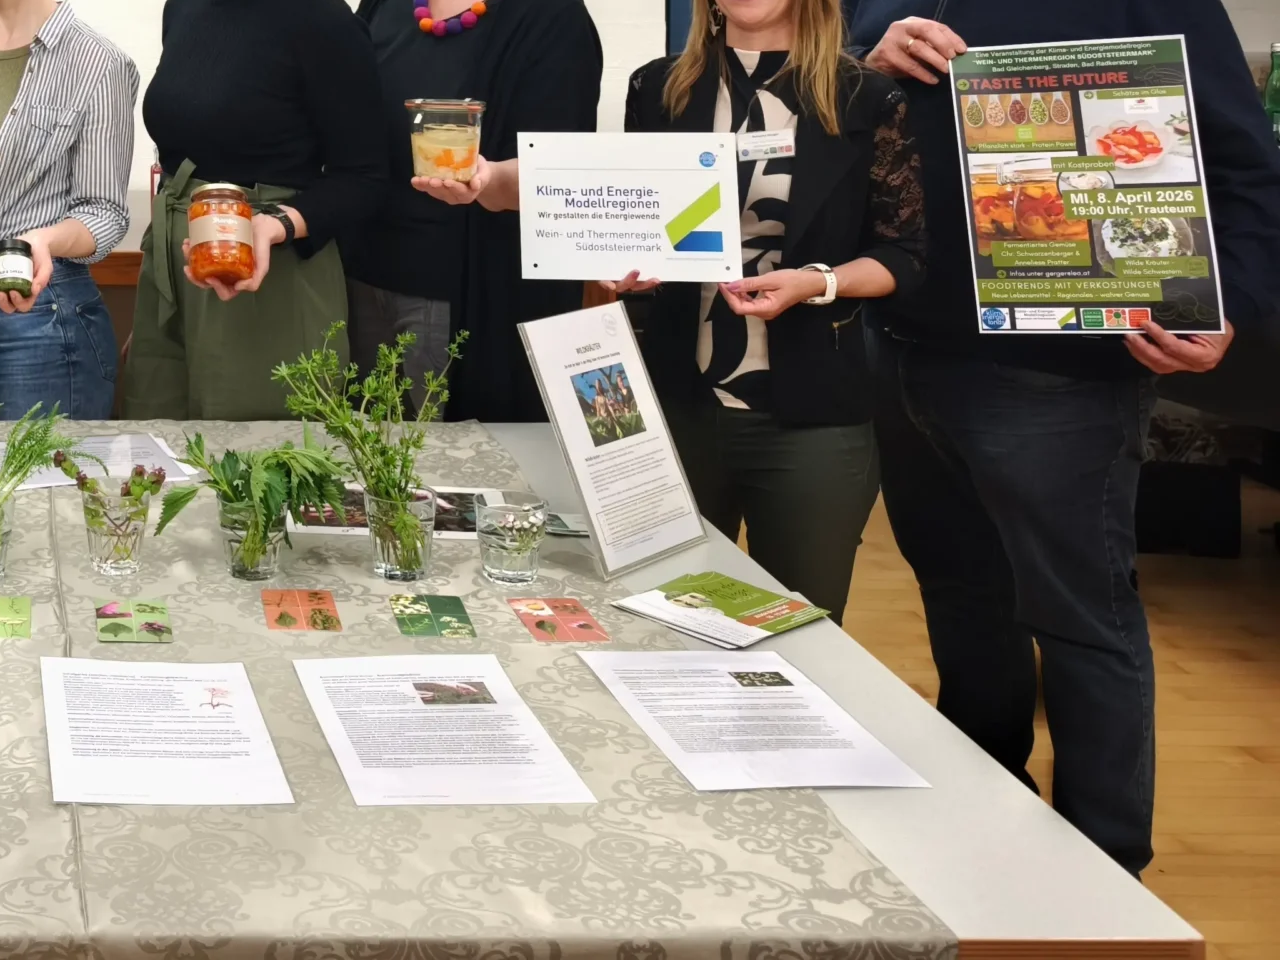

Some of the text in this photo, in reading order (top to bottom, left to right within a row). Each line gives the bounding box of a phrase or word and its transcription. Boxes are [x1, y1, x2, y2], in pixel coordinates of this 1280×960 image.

[990, 49, 1034, 57] Veranstaltung
[1084, 42, 1151, 52] Energiemodellregion
[1014, 54, 1075, 63] THERMENREGION
[1005, 63, 1051, 72] Gleichenberg,
[1095, 59, 1137, 67] Radkersburg
[969, 70, 1129, 91] TASTE THE FUTURE
[978, 142, 1009, 150] Pflanzlich
[1067, 160, 1115, 169] Kostproben
[536, 185, 659, 199] Klima- und Energie-
[1069, 190, 1194, 206] MI, 8. April 2026
[565, 198, 660, 211] Modellregionen
[1071, 204, 1196, 216] 19:00 Uhr, Trauteum
[538, 211, 551, 219] Wir
[553, 212, 589, 220] gestalten
[605, 212, 660, 221] Energiewende
[535, 229, 661, 241] Wein- und Thermenregion
[575, 242, 662, 252] Südoststeiermark
